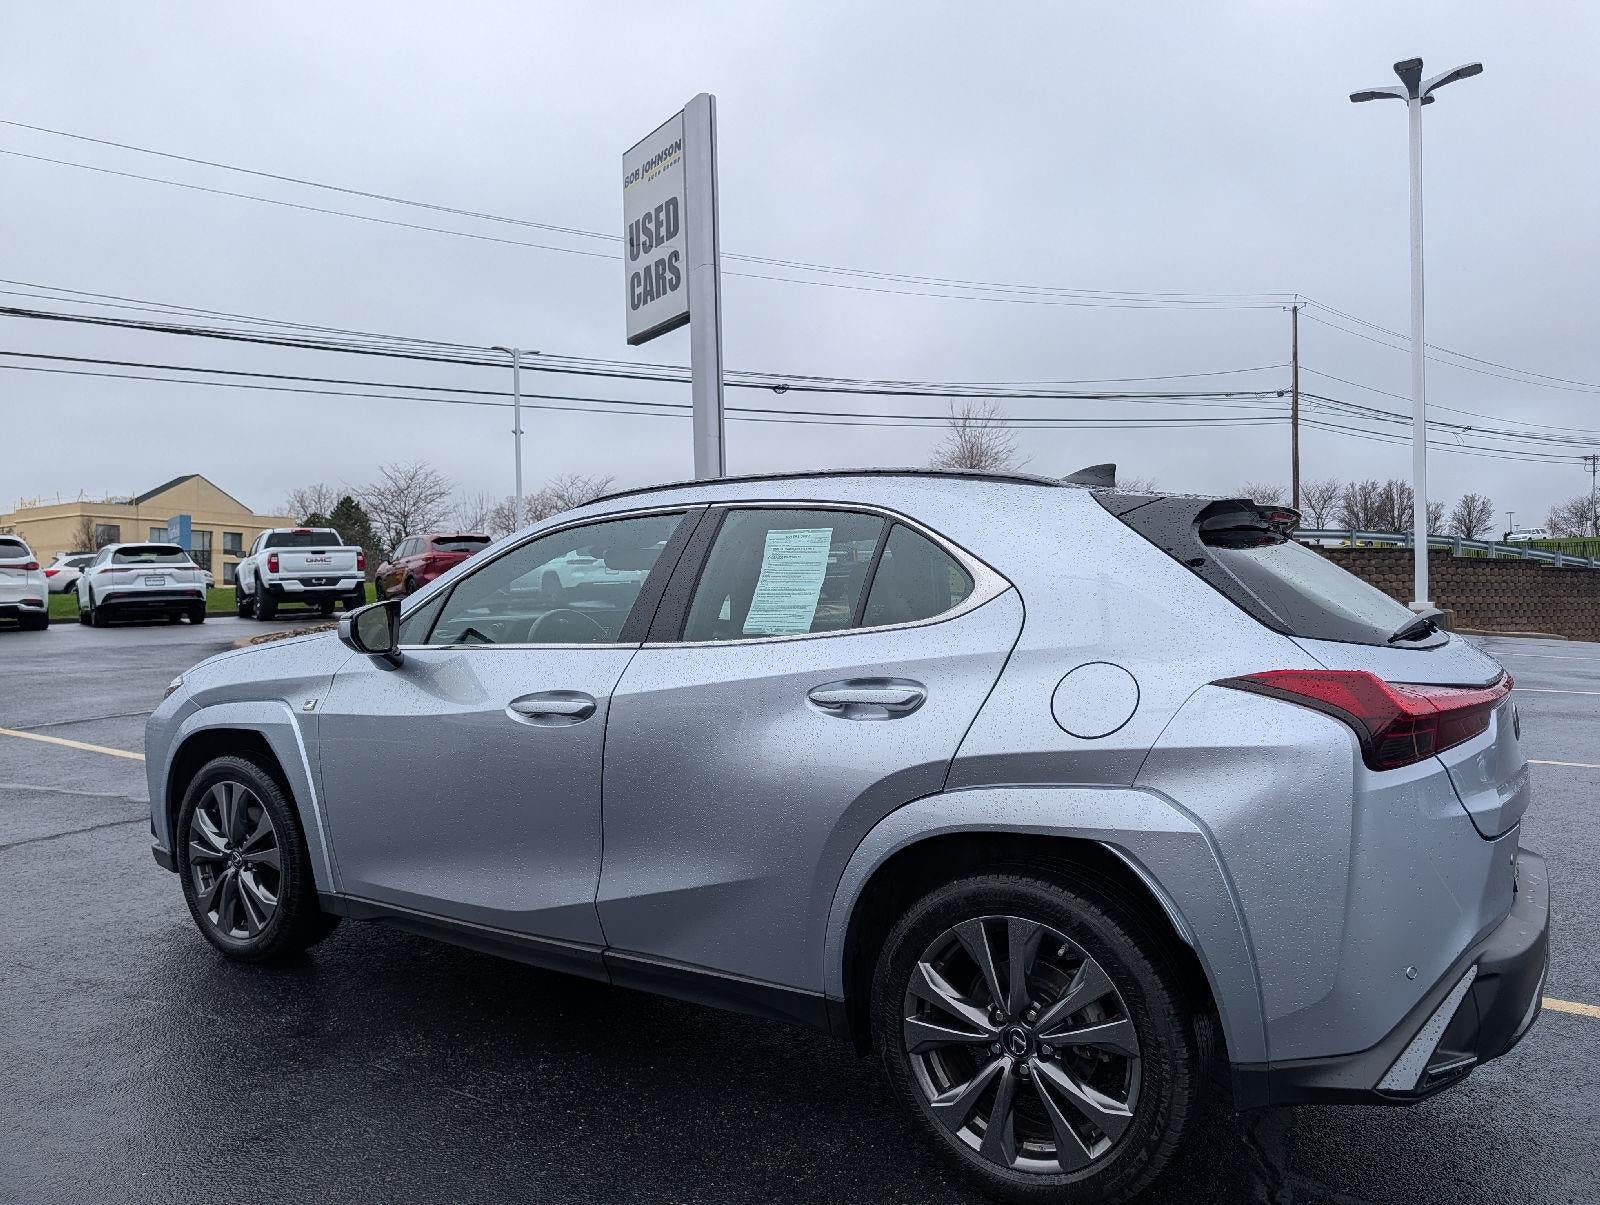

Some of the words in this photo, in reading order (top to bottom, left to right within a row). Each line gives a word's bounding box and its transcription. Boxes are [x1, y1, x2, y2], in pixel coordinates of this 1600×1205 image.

[624, 167, 640, 188] BOB
[641, 138, 682, 180] JOHNSON
[628, 196, 680, 262] USED
[629, 249, 681, 311] CARS
